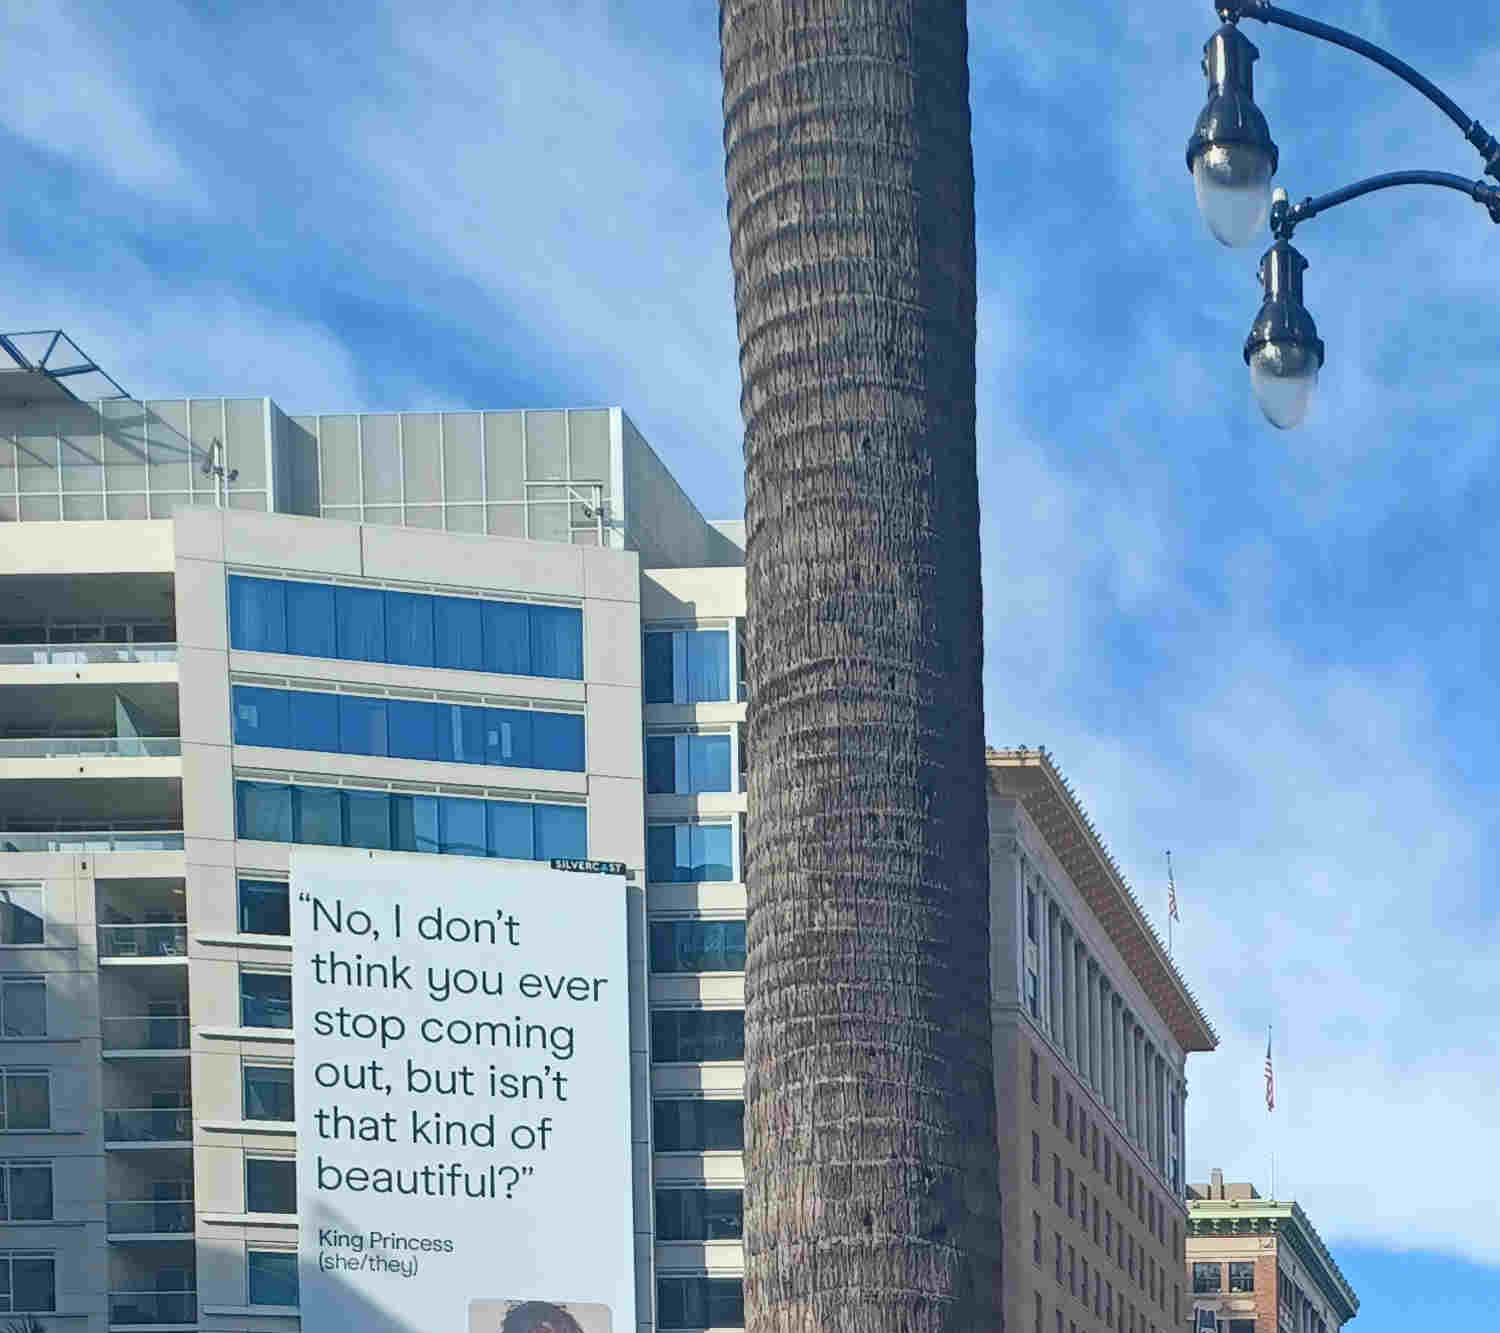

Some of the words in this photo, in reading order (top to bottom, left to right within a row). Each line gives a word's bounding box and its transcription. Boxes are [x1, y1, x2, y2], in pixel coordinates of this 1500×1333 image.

[394, 904, 401, 937] I
[311, 952, 411, 990] think
[426, 966, 503, 1002] you
[518, 970, 608, 1002] ever
[313, 1007, 406, 1048] stop
[420, 1016, 574, 1059] coming
[314, 1058, 392, 1097] out,
[407, 1060, 474, 1096] but
[314, 1107, 397, 1143] that
[411, 1110, 495, 1148] kind
[511, 1116, 552, 1151] of
[318, 1230, 363, 1252] King
[369, 1231, 454, 1253] Princess
[318, 1252, 418, 1276] (she/they)
